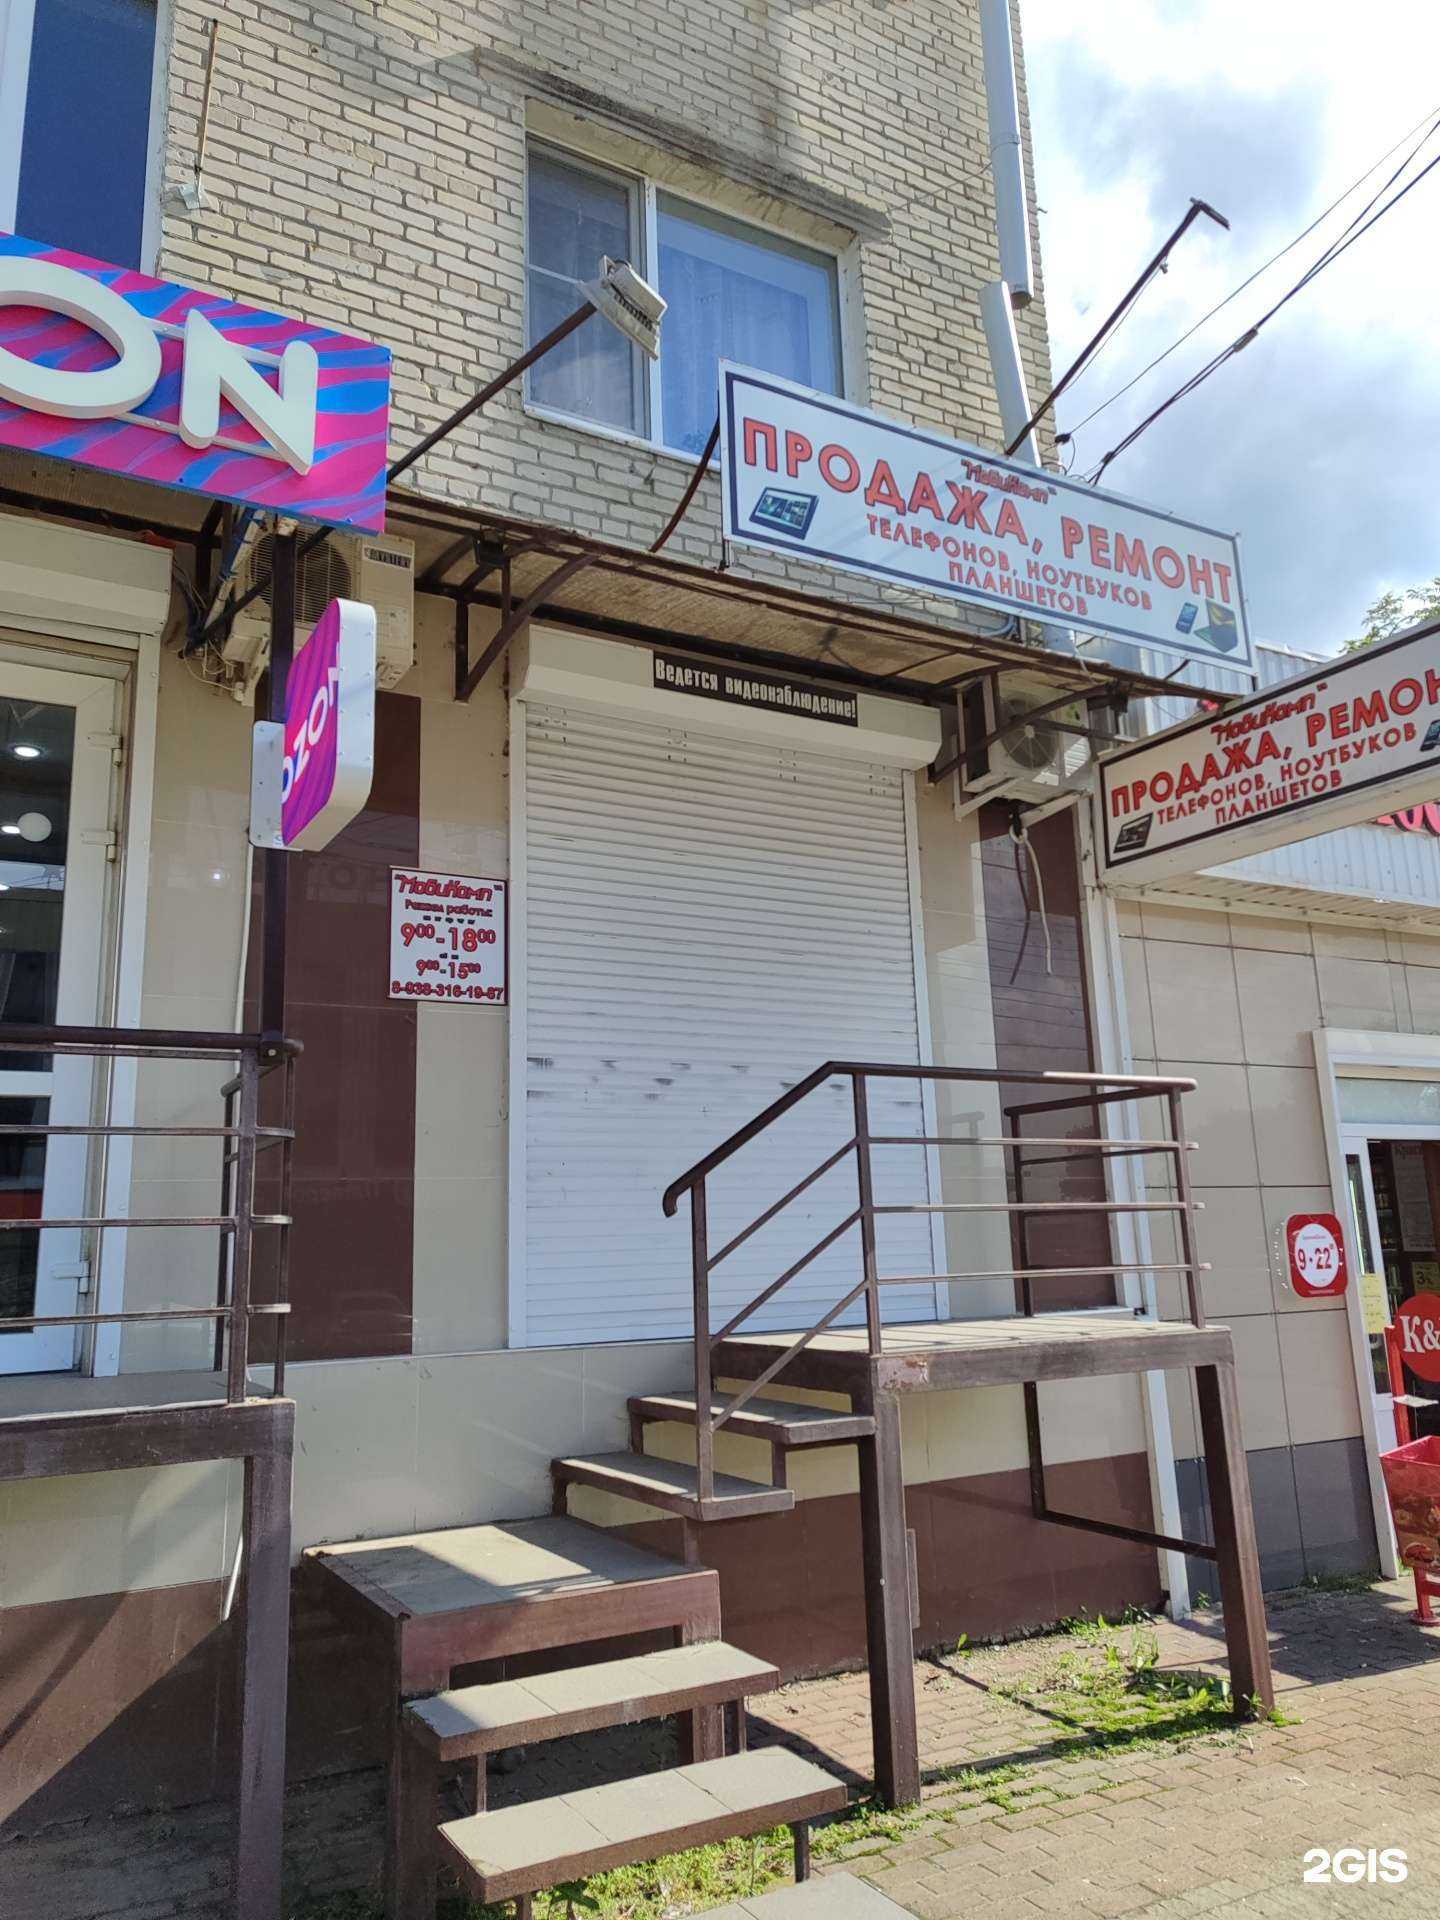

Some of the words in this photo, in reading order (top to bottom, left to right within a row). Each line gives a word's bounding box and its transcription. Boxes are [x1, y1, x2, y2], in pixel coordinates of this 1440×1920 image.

[743, 417, 1042, 555] ПРОДАЖА,
[1061, 516, 1232, 603] РЕМОНТ
[867, 513, 1017, 577] ТЕЛЕФОНОВ,
[1027, 560, 1152, 611] НОУТБУКОВ
[949, 561, 1088, 616] ПЛАНШЕТОВ
[655, 659, 718, 691] Ведется
[725, 676, 856, 718] видеонаблюдение!
[1111, 730, 1292, 818] ПРОДАЖА,
[1157, 773, 1272, 825] ТЕЛЕФОНОВ,
[1281, 722, 1417, 781] НОУТБУКОВ
[1215, 769, 1342, 825] ПЛАНШЕТОВ
